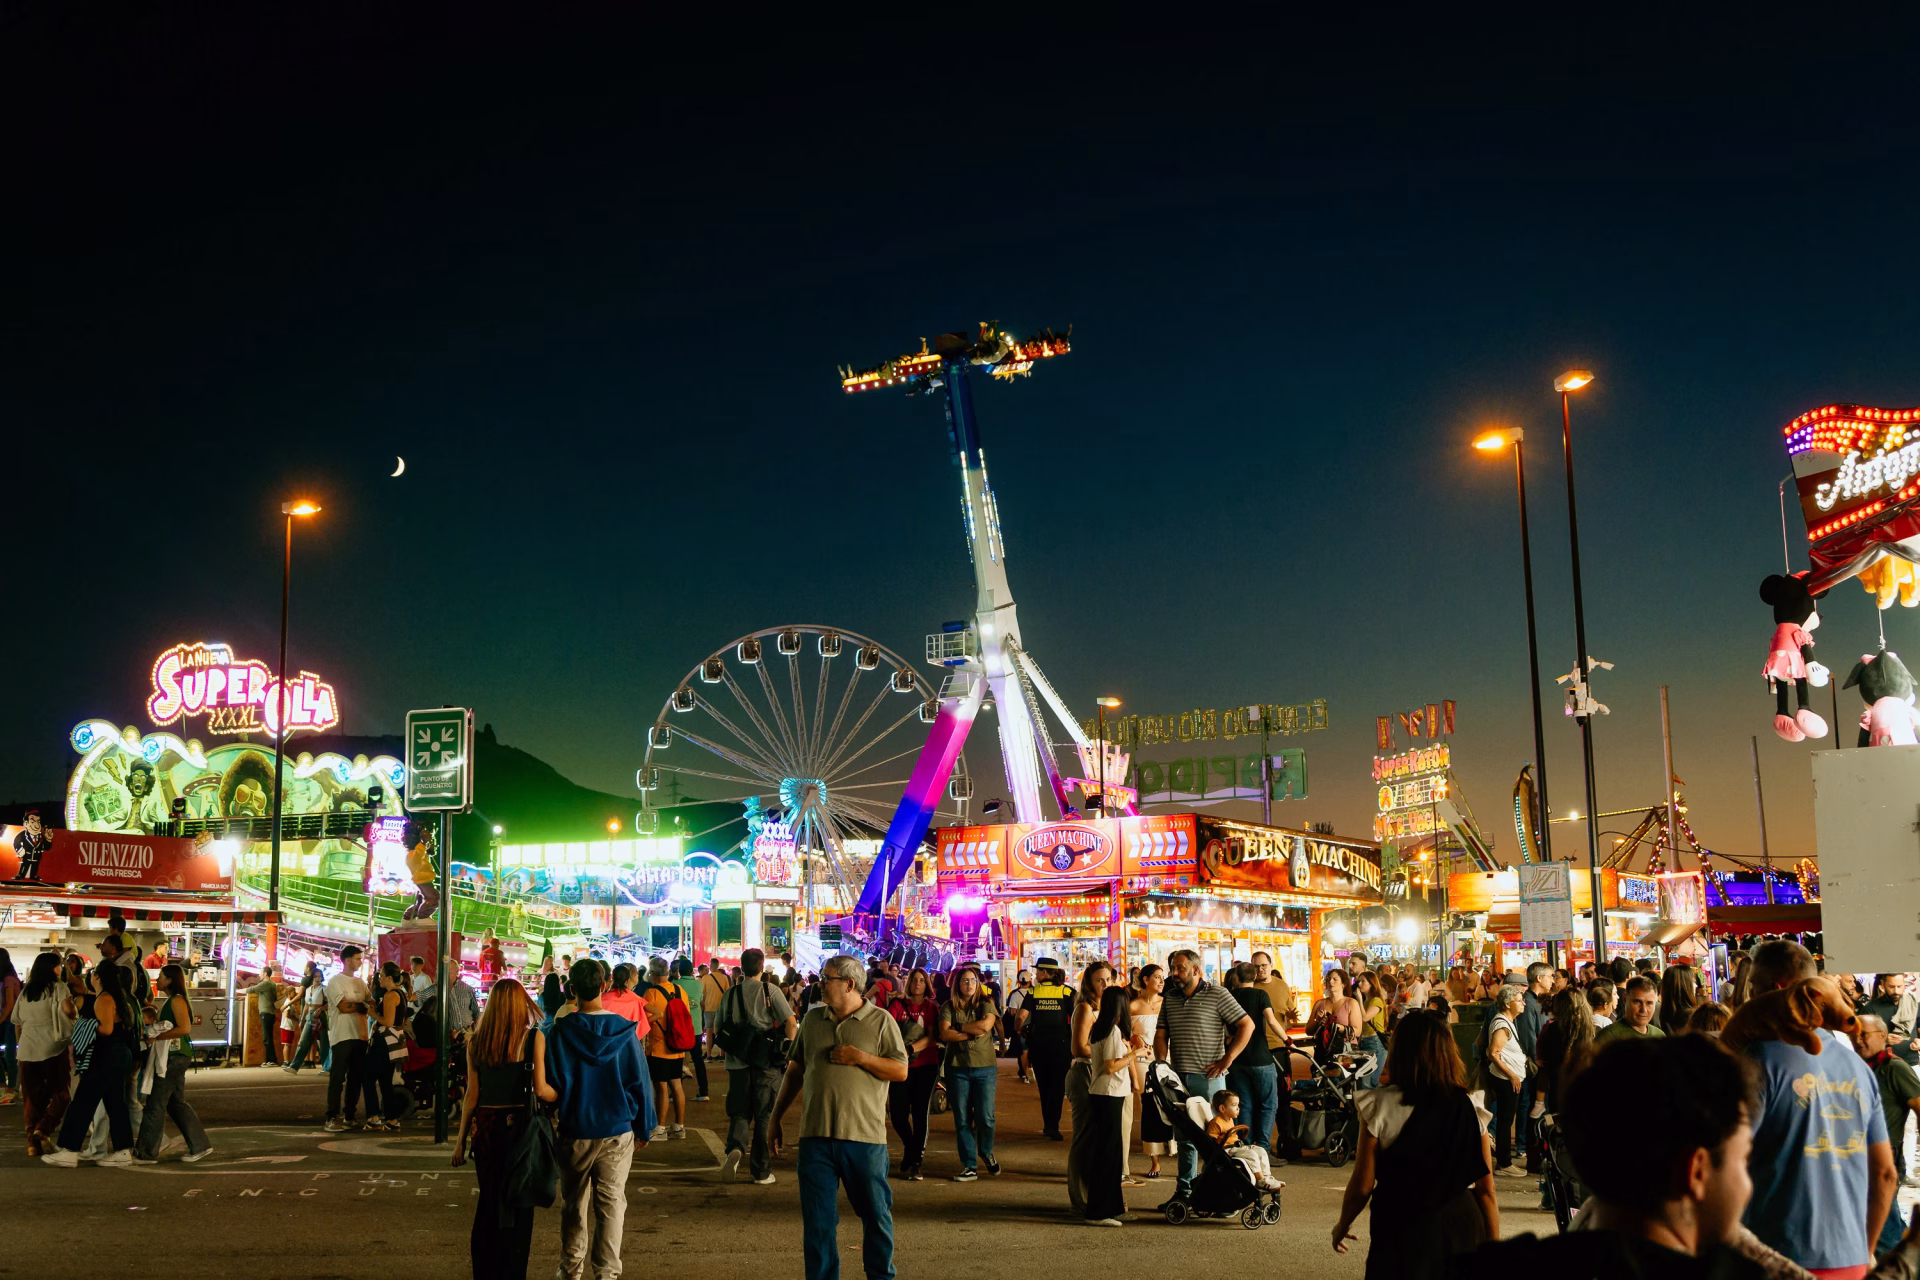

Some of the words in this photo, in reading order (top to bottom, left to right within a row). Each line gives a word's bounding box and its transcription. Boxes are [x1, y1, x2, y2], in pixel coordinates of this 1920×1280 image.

[153, 655, 267, 719] SUPER
[214, 706, 259, 728] XXXL
[264, 678, 334, 731] OLLA
[1374, 757, 1409, 781] SUPER
[417, 782, 452, 790] ENCUENTRO
[78, 841, 154, 869] SILENZZIO
[1024, 830, 1057, 859] QUEEN
[1057, 830, 1104, 854] MACHINE
[92, 867, 114, 877] PASTA
[114, 869, 142, 879] FRESCA
[757, 858, 793, 883] OLLA
[1205, 837, 1291, 877] QUEEN
[1309, 842, 1382, 893] MACHINE
